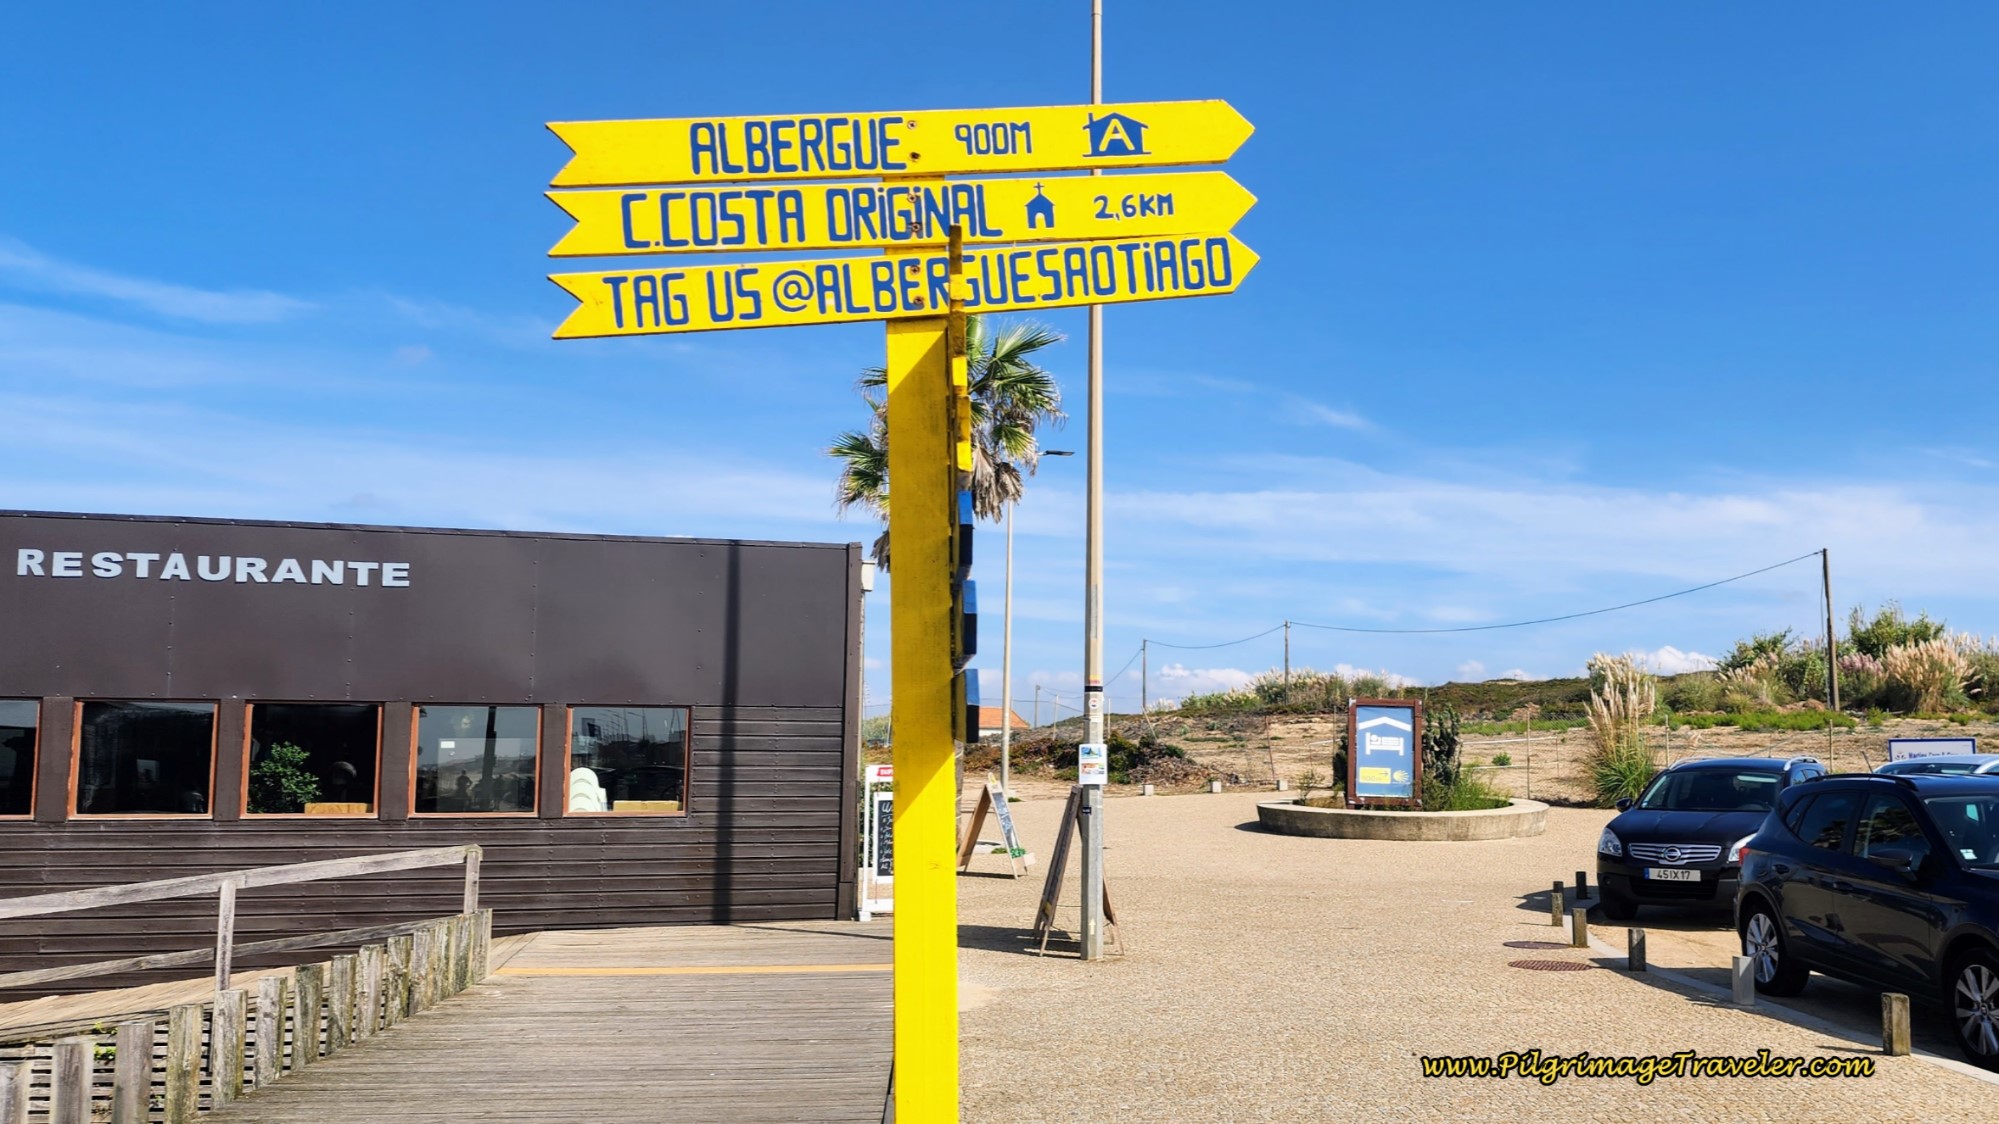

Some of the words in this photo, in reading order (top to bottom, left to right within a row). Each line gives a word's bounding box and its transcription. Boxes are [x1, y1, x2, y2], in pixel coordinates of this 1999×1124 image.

[690, 116, 907, 175] ALBERGUE
[954, 121, 1033, 156] 900M
[620, 188, 806, 249] C.COSTA
[602, 272, 690, 328] TAG
[706, 268, 763, 322] US
[16, 547, 411, 587] RESTAURANTE
